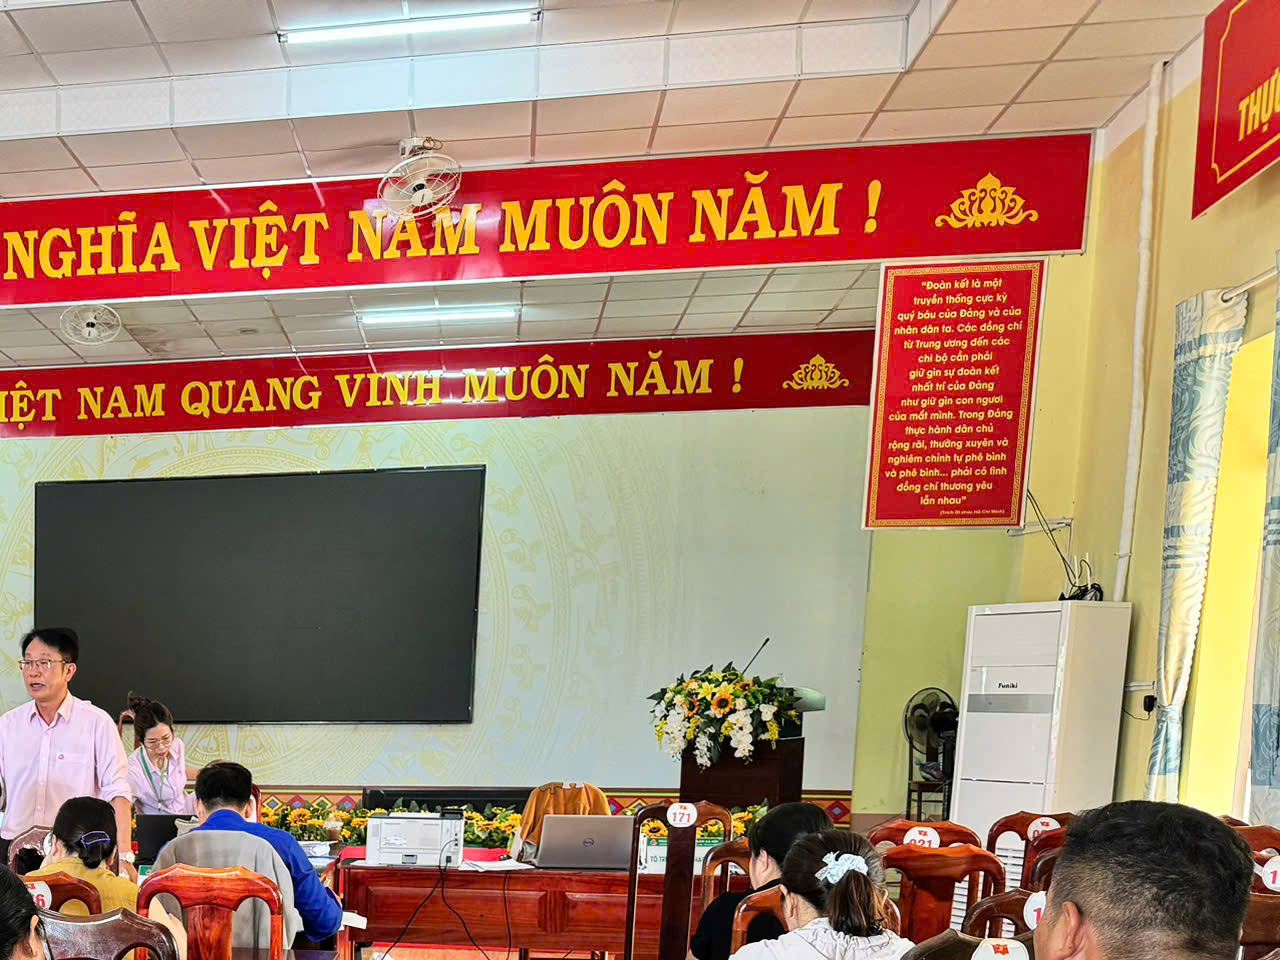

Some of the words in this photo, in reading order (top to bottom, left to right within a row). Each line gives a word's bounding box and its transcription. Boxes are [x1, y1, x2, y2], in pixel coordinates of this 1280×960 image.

[3, 211, 180, 280] NGHĨA
[189, 199, 329, 279] VIỆT
[347, 203, 482, 262] NAM
[500, 179, 674, 254] MUÔN
[689, 168, 843, 243] NĂM
[865, 179, 882, 233] !
[955, 278, 969, 288] kết
[972, 279, 980, 288] là
[984, 279, 1002, 289] một
[914, 294, 942, 306] truyền
[946, 294, 972, 305] thống
[976, 295, 993, 304] cực
[996, 294, 1007, 303] kỳ
[898, 312, 915, 321] quý
[918, 310, 935, 319] báu
[939, 309, 957, 318] của
[960, 307, 985, 319] Đảng
[989, 307, 999, 316] và
[1003, 306, 1021, 315] của
[895, 325, 917, 335] nhân
[921, 325, 939, 334] dân
[942, 325, 954, 333] ta.
[957, 324, 976, 332] Các
[980, 321, 1004, 333] đồng
[1008, 321, 1022, 330] chí
[904, 340, 913, 349] từ
[916, 339, 941, 350] Trung
[944, 340, 967, 349] ương
[971, 336, 988, 346] đến
[992, 337, 1010, 345] các
[918, 355, 932, 363] chi
[936, 354, 947, 364] bộ
[951, 352, 968, 361] cần
[972, 351, 992, 362] phải
[909, 369, 925, 379] giữ
[927, 368, 941, 378] gìn
[944, 369, 955, 379] sự
[958, 367, 981, 376] đoàn
[985, 364, 999, 374] kết
[77, 383, 166, 420] NAM
[181, 375, 321, 420] QUANG
[335, 368, 442, 407] VINH
[462, 354, 590, 404] MUÔN
[607, 350, 713, 398] NĂM
[732, 358, 744, 393] !
[912, 381, 933, 391] nhất
[936, 382, 945, 390] trí
[948, 380, 965, 390] của
[969, 378, 994, 390] Đảng
[902, 398, 918, 406] như
[921, 397, 936, 408] giữ
[938, 396, 953, 407] gìn
[956, 397, 973, 405] con
[889, 412, 906, 421] của
[910, 410, 927, 420] mắt
[931, 411, 955, 419] mình.
[959, 410, 984, 420] Trong
[988, 410, 1013, 419] Đảng
[905, 426, 925, 435] thực
[929, 424, 951, 433] hành
[976, 423, 993, 432] chủ
[889, 441, 909, 451] rộng
[912, 439, 926, 449] rãi,
[930, 438, 962, 449] thường
[966, 439, 993, 448] xuyên
[997, 437, 1008, 446] và
[888, 454, 922, 465] nghiêm
[925, 453, 950, 462] chỉnh
[954, 453, 962, 464] tự
[965, 454, 983, 463] phê
[986, 452, 1006, 461] bình
[885, 469, 896, 477] và
[899, 469, 917, 478] phê
[951, 467, 972, 478] phải
[975, 467, 986, 475] có
[897, 481, 920, 492] đồng
[924, 481, 938, 490] chí
[941, 481, 973, 491] thương
[976, 482, 992, 491] yêu
[672, 812, 691, 823] 171
